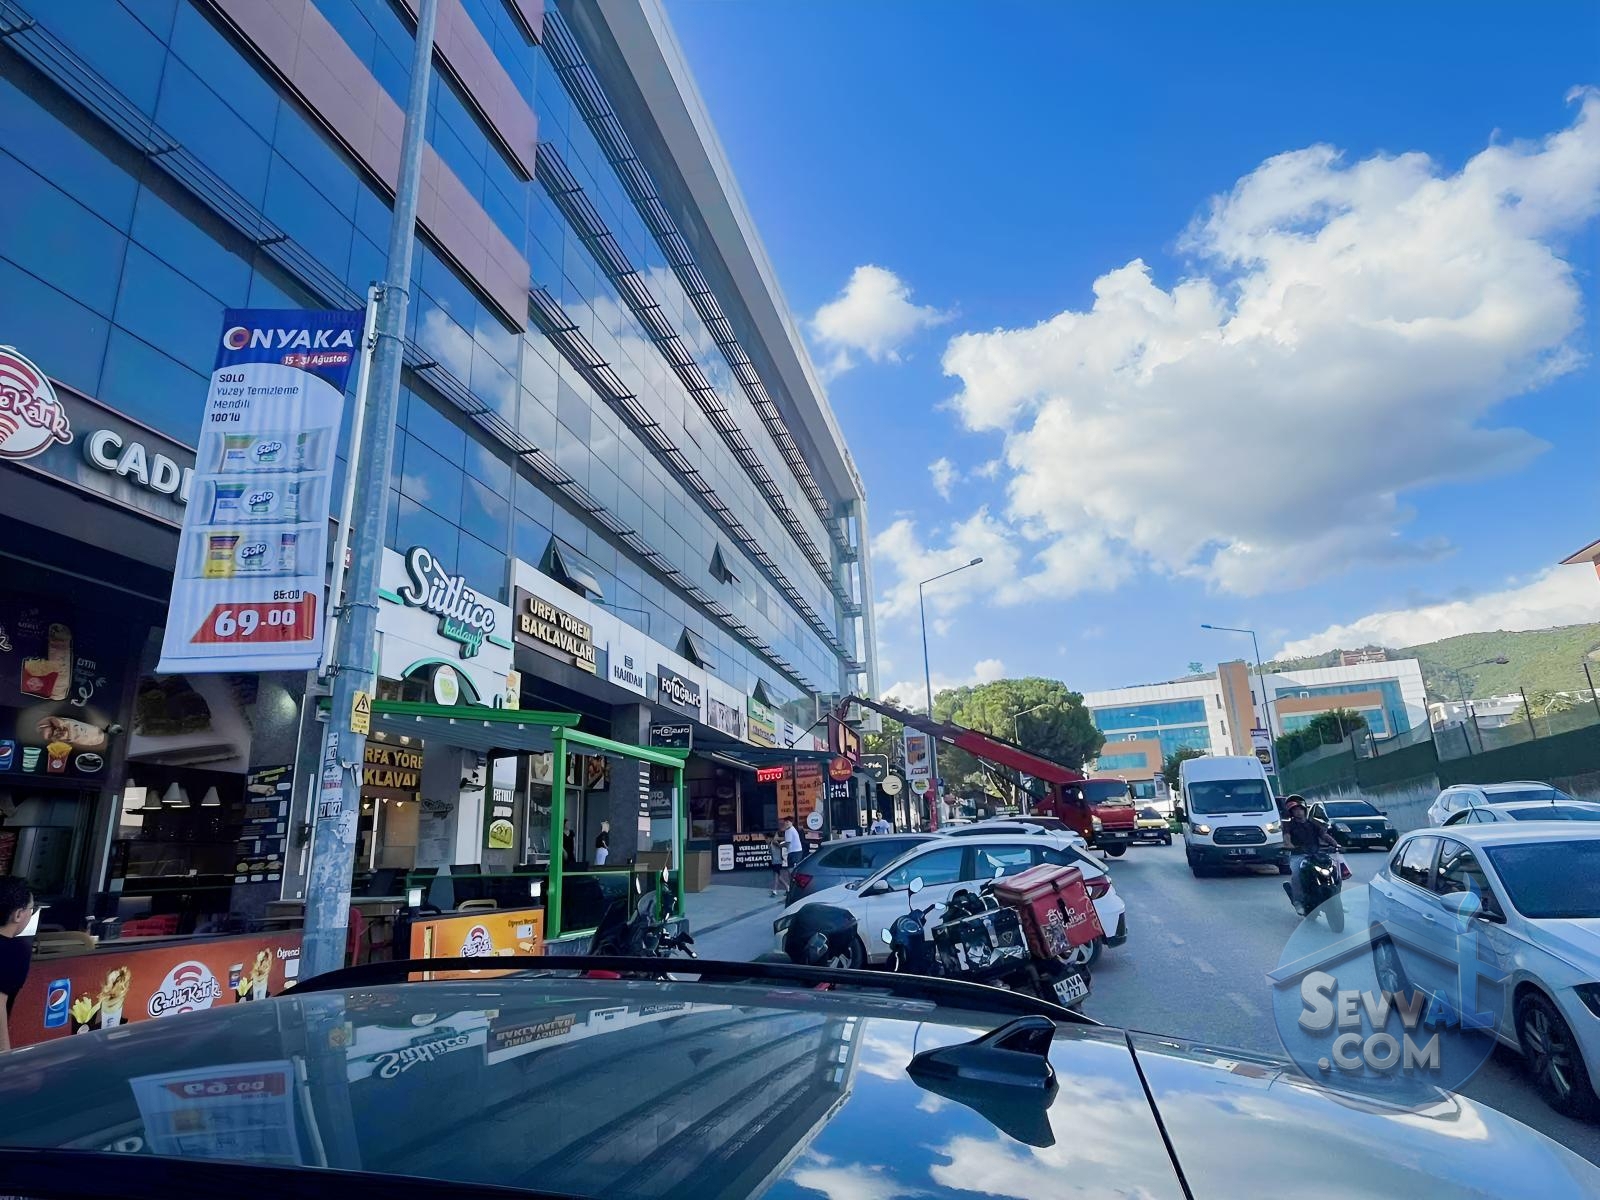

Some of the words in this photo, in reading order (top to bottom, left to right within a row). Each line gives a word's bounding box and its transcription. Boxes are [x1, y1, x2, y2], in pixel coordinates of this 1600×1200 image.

[218, 373, 245, 383] SOLO
[256, 442, 281, 456] Solo
[248, 491, 273, 505] Solo
[241, 543, 267, 559] Solo
[404, 547, 496, 633] Sütlüce
[530, 598, 557, 625] URFA
[214, 608, 296, 637] 69.00
[521, 614, 596, 664] BAKLAVALARI
[1066, 975, 1082, 990] AVA
